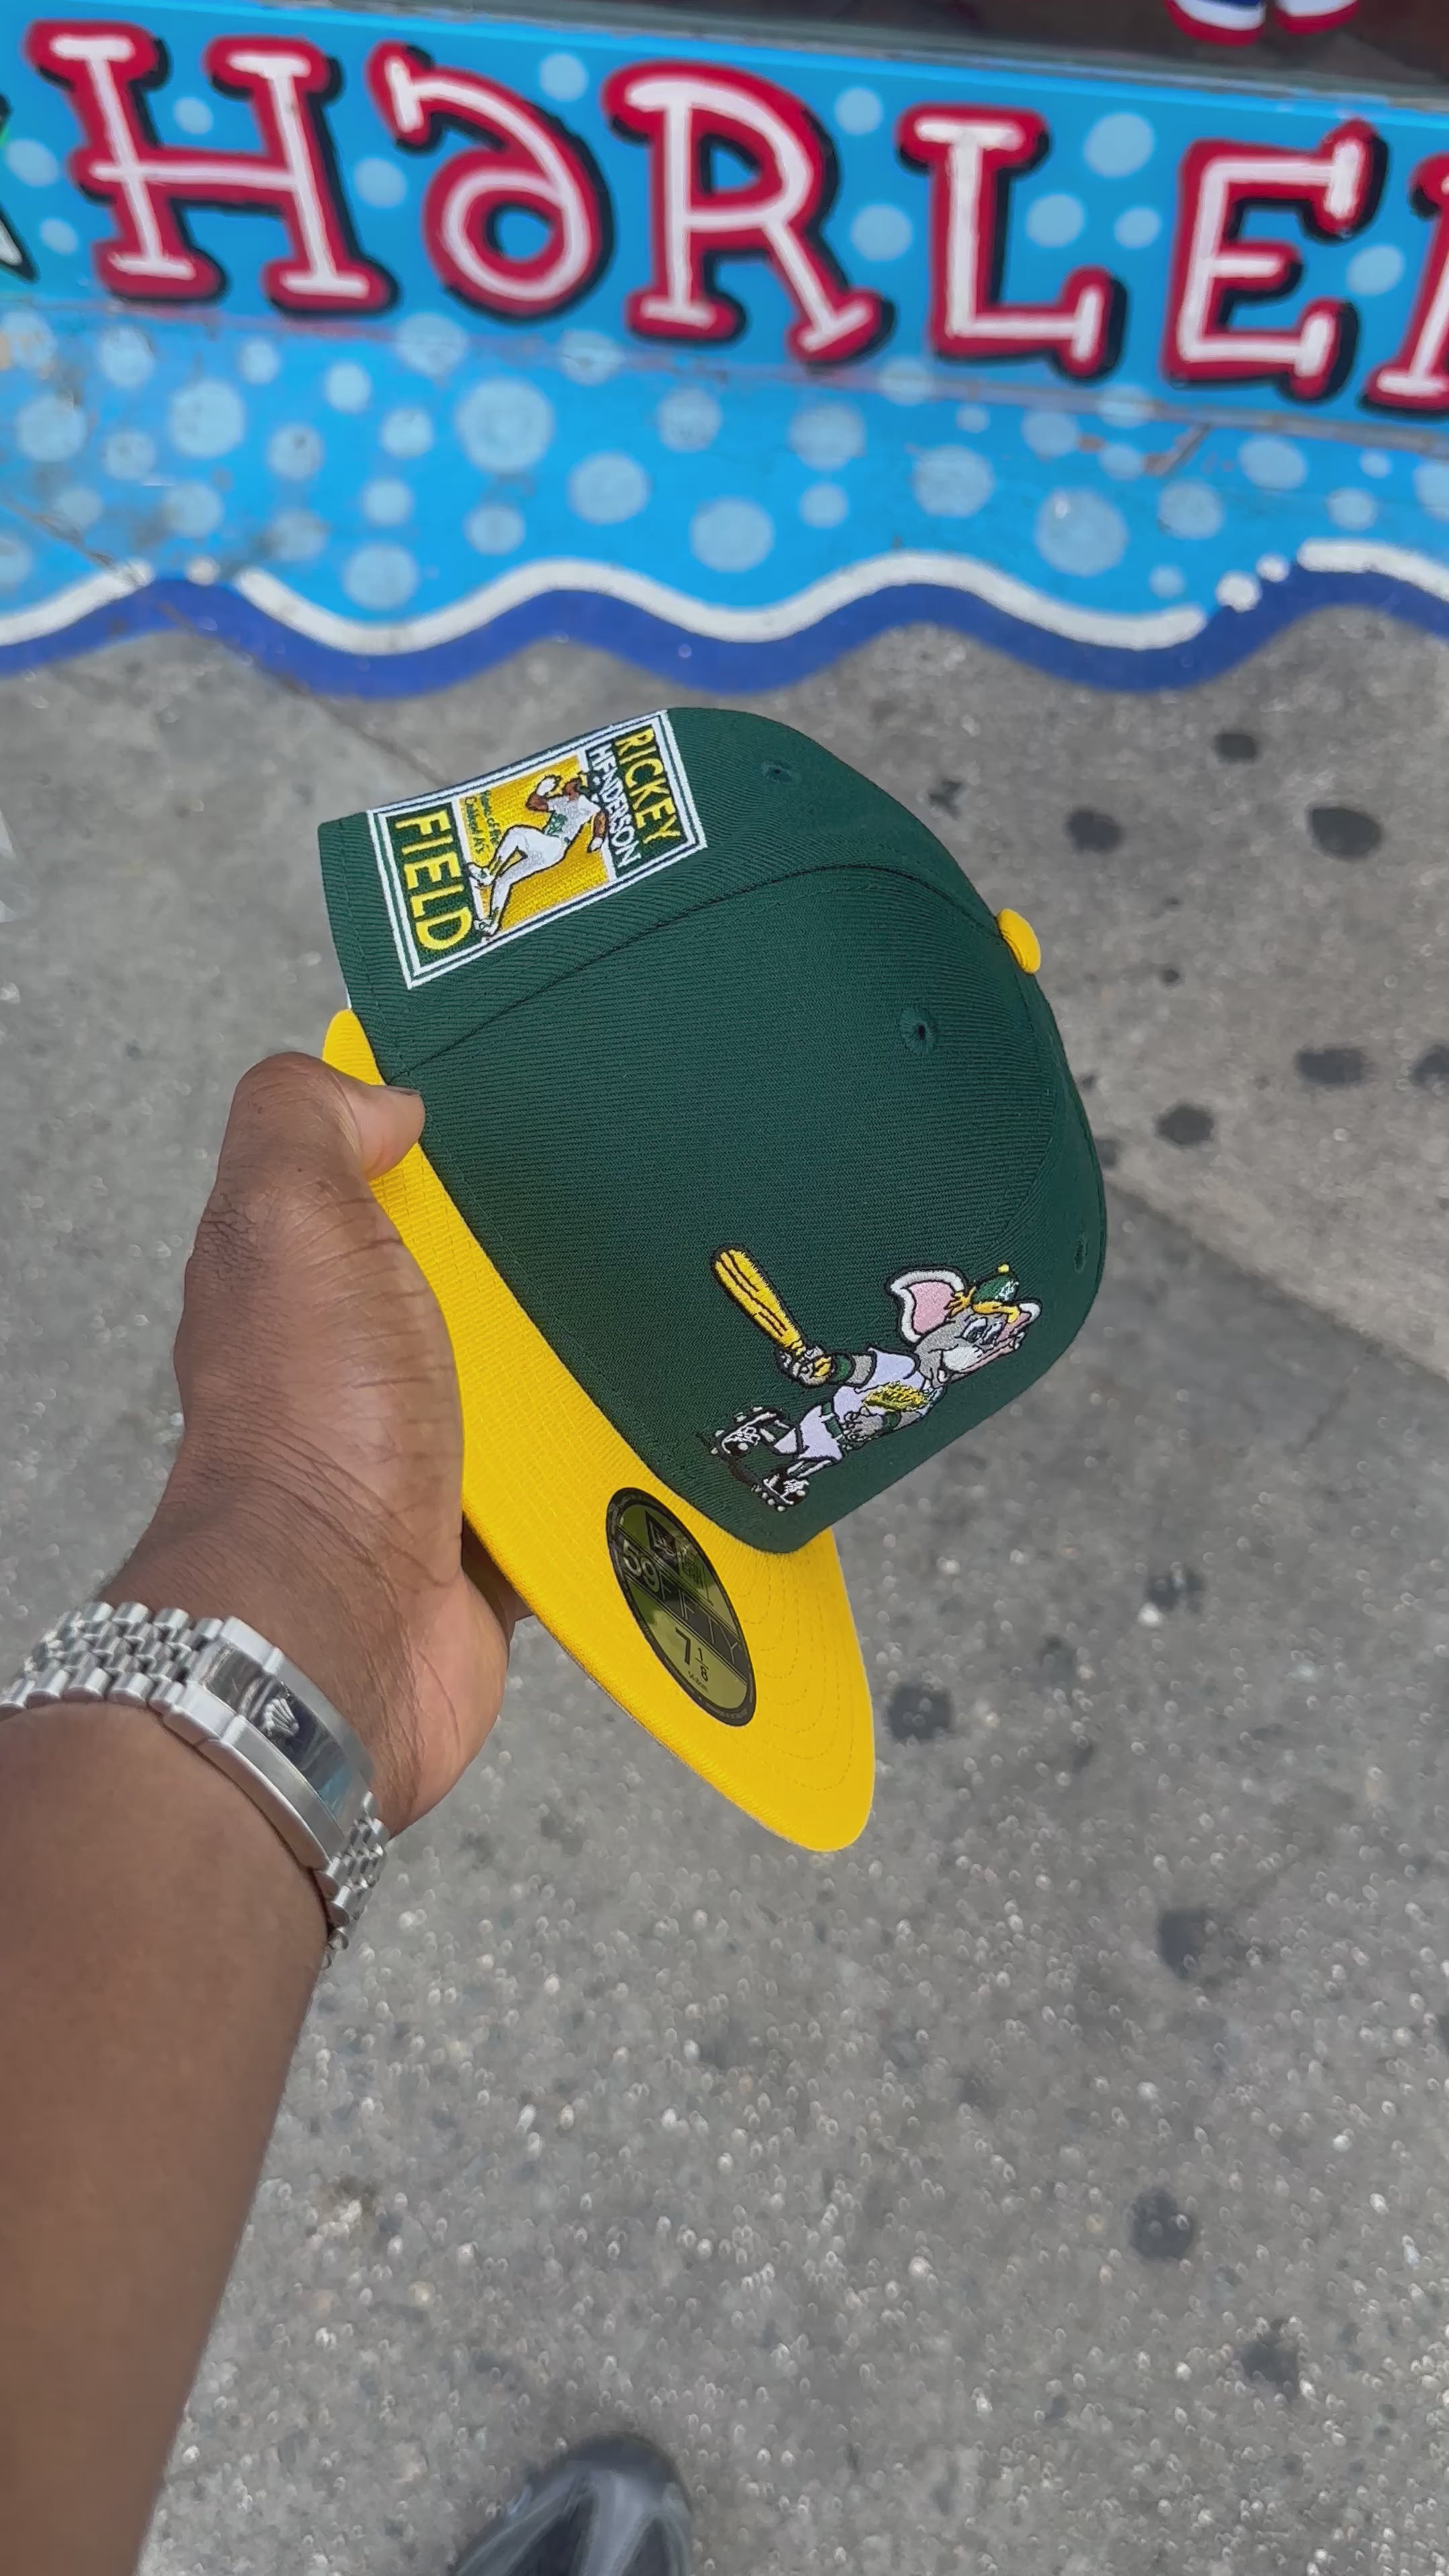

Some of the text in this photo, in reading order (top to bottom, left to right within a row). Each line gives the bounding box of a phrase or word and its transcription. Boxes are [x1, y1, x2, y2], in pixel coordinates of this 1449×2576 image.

[589, 743, 642, 869] HENDERSON
[614, 728, 681, 845] RICKEY
[394, 809, 472, 951] FIELD
[623, 1538, 739, 1665] 59FIFTY
[675, 1627, 691, 1666] 7
